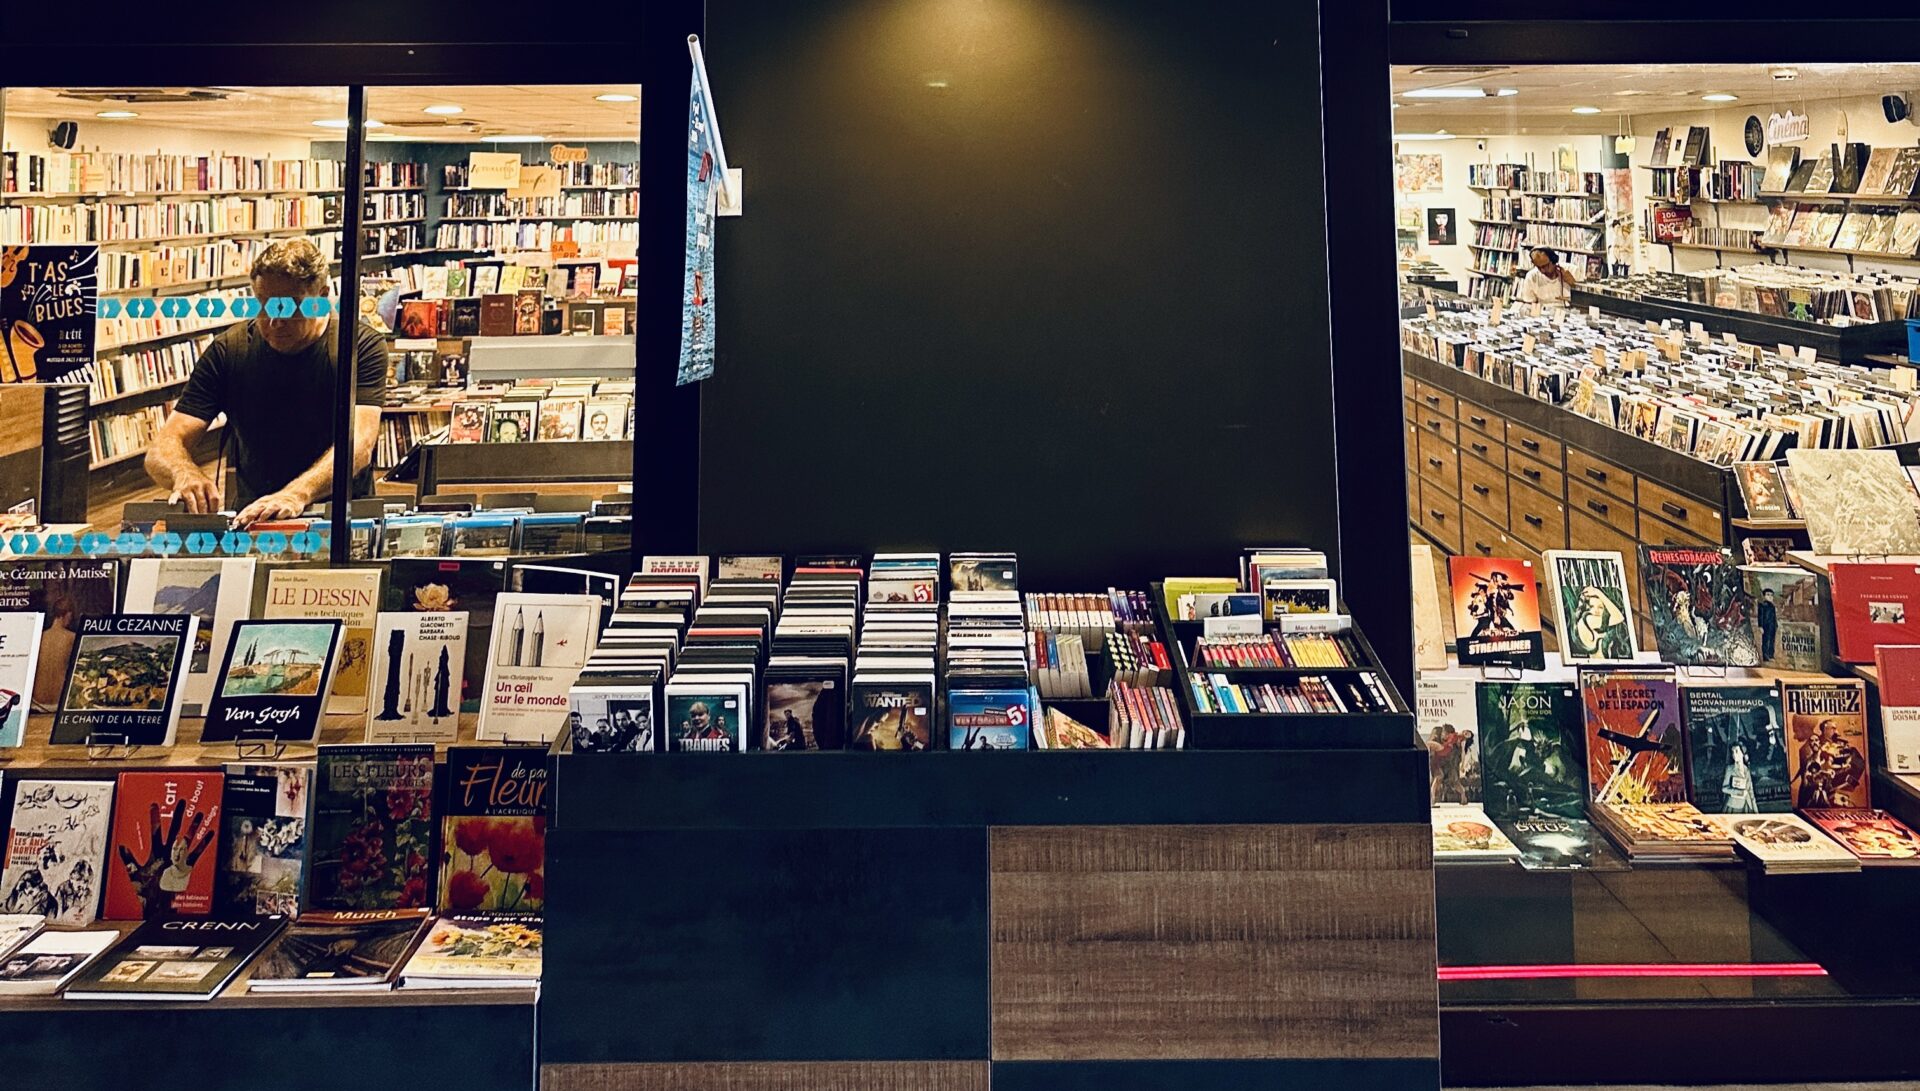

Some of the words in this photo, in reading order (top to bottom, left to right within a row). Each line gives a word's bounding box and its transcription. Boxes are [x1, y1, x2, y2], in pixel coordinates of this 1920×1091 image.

[234, 215, 240, 224] C
[325, 209, 335, 219] C
[62, 224, 71, 234] B
[29, 261, 68, 283] T'AS
[160, 267, 168, 277] E
[178, 265, 184, 274] F
[35, 298, 83, 323] BLUES
[11, 568, 58, 580] Cézanne
[59, 568, 66, 579] à
[68, 567, 111, 579] Matisse
[1559, 559, 1621, 588] FATALE
[272, 588, 297, 606] LE
[302, 588, 374, 607] DESSIN
[320, 610, 364, 619] techniques
[83, 619, 112, 632] PAUL
[117, 619, 184, 633] CEZANNE
[1468, 639, 1532, 655] STREAMLINER
[496, 682, 512, 693] Un
[514, 682, 533, 693] œil
[494, 695, 511, 705] sur
[514, 694, 525, 705] le
[527, 694, 567, 706] monde
[1606, 690, 1617, 699] LE
[1621, 689, 1657, 699] SECRET
[864, 697, 921, 708] WANTED
[1499, 696, 1552, 709] JASON
[1599, 701, 1611, 710] DE
[1613, 700, 1665, 710] L'ESPADON
[224, 707, 255, 721] Van
[256, 705, 301, 725] Gogh
[1424, 708, 1448, 717] PARIS
[60, 716, 69, 724] LE
[72, 715, 104, 724] CHANT
[107, 715, 119, 724] DE
[122, 716, 133, 724] LA
[137, 715, 162, 725] TERRE
[333, 765, 361, 778] LES
[367, 764, 427, 778] FLEURS
[511, 761, 526, 779] de
[460, 756, 547, 807] Fleur
[161, 782, 178, 818] L'art
[186, 804, 196, 818] du
[192, 780, 204, 803] bout
[333, 911, 398, 920] Munch
[162, 921, 260, 931] CRENN
